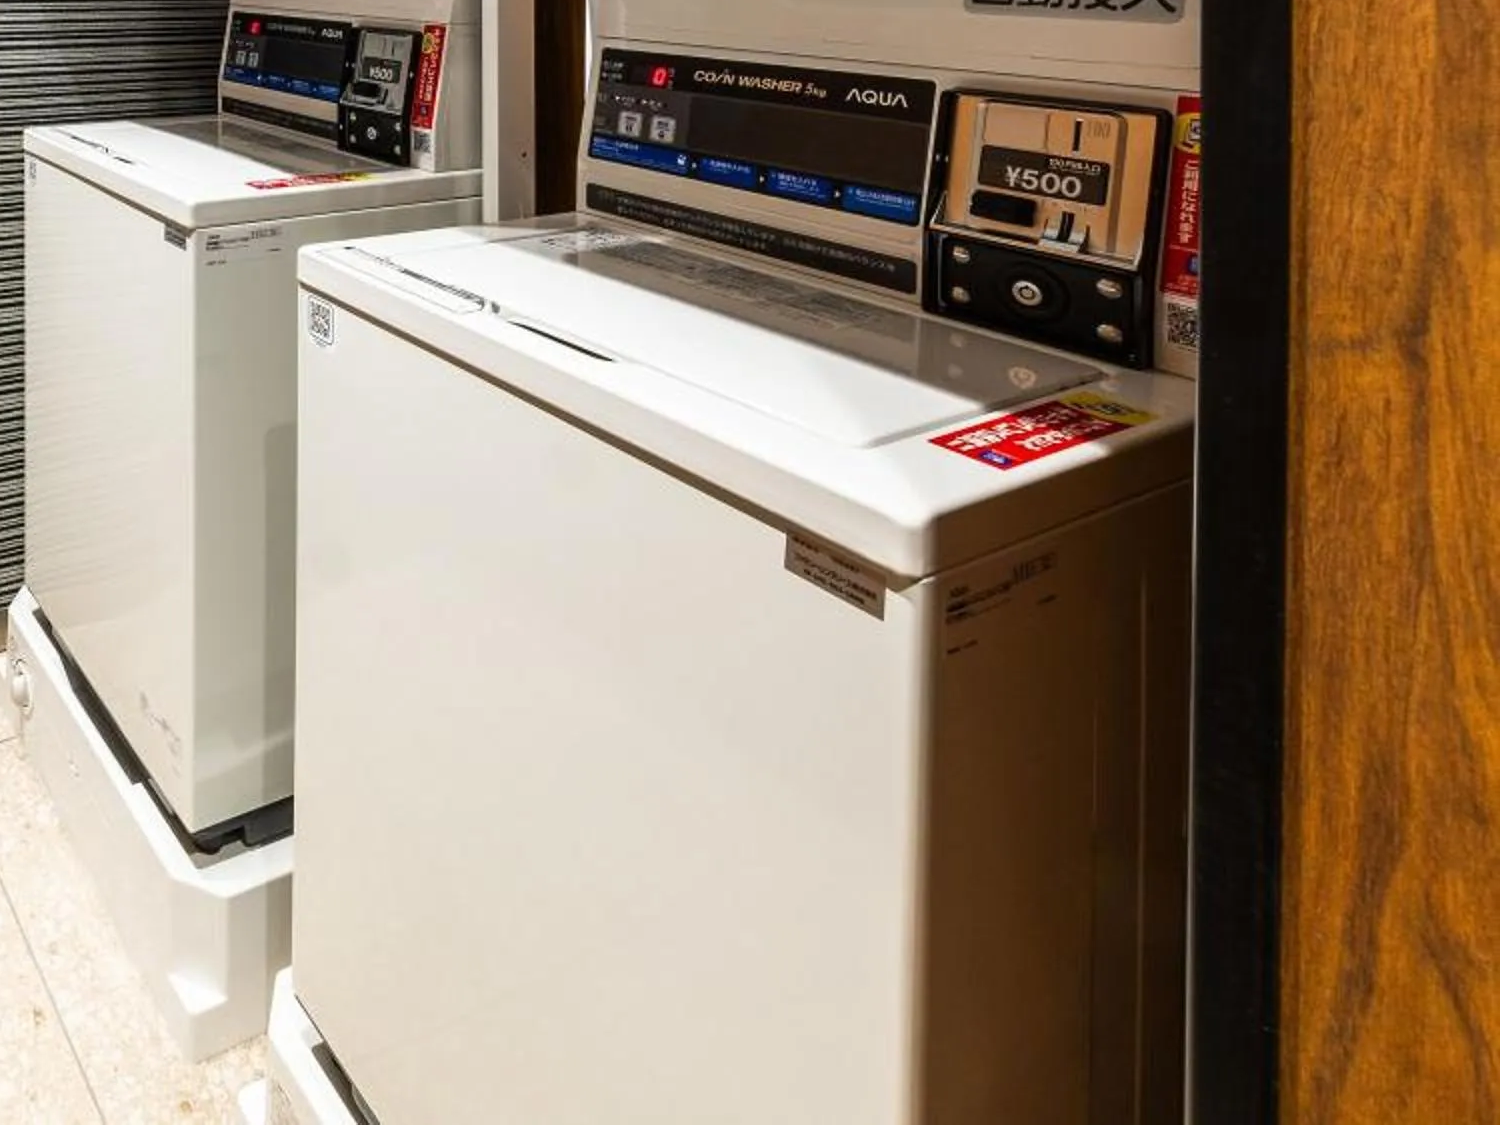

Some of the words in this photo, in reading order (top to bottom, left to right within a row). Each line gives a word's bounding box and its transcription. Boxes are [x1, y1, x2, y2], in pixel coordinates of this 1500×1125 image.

[369, 67, 393, 80] ¥500
[652, 66, 668, 86] 0
[738, 75, 803, 94] WASHER
[845, 88, 909, 108] AQUA
[1005, 165, 1082, 198] ¥500
